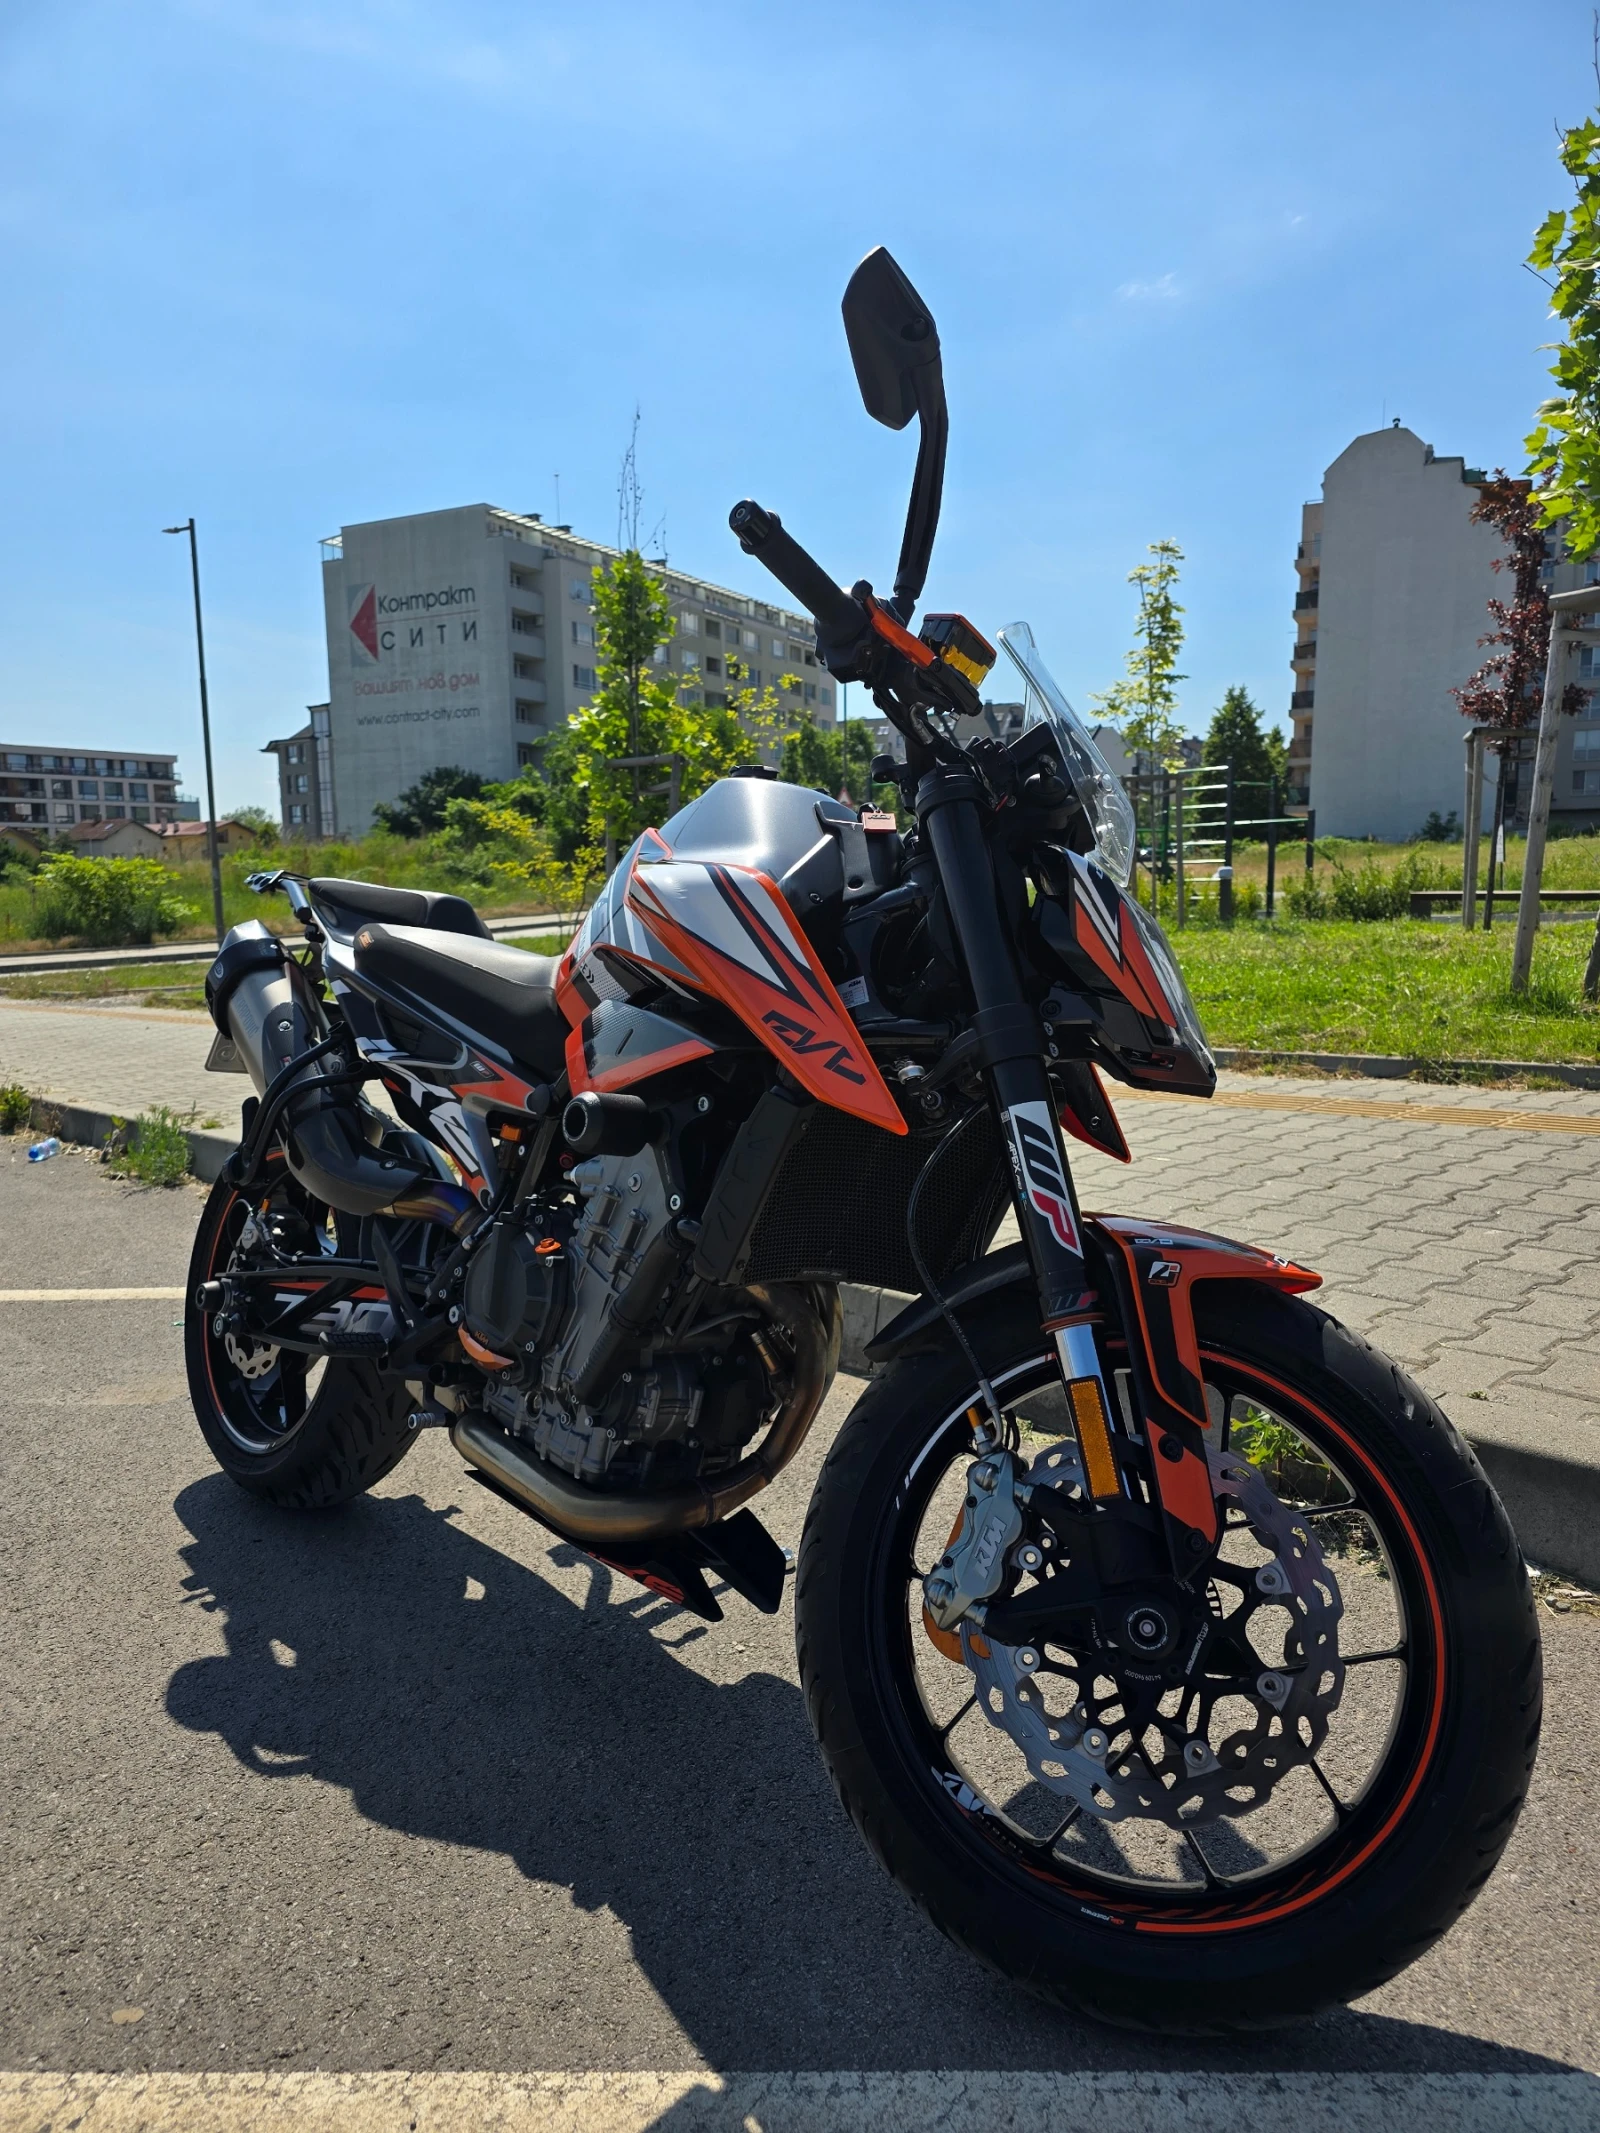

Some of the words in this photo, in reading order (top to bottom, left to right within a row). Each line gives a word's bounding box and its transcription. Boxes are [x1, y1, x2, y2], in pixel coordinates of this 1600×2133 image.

[378, 586, 476, 614] Контракт
[417, 672, 446, 690] нов
[450, 671, 480, 692] дом
[356, 706, 481, 726] www.contract-city.com
[1007, 1139, 1022, 1173] APEX
[974, 1516, 1008, 1579] KTM
